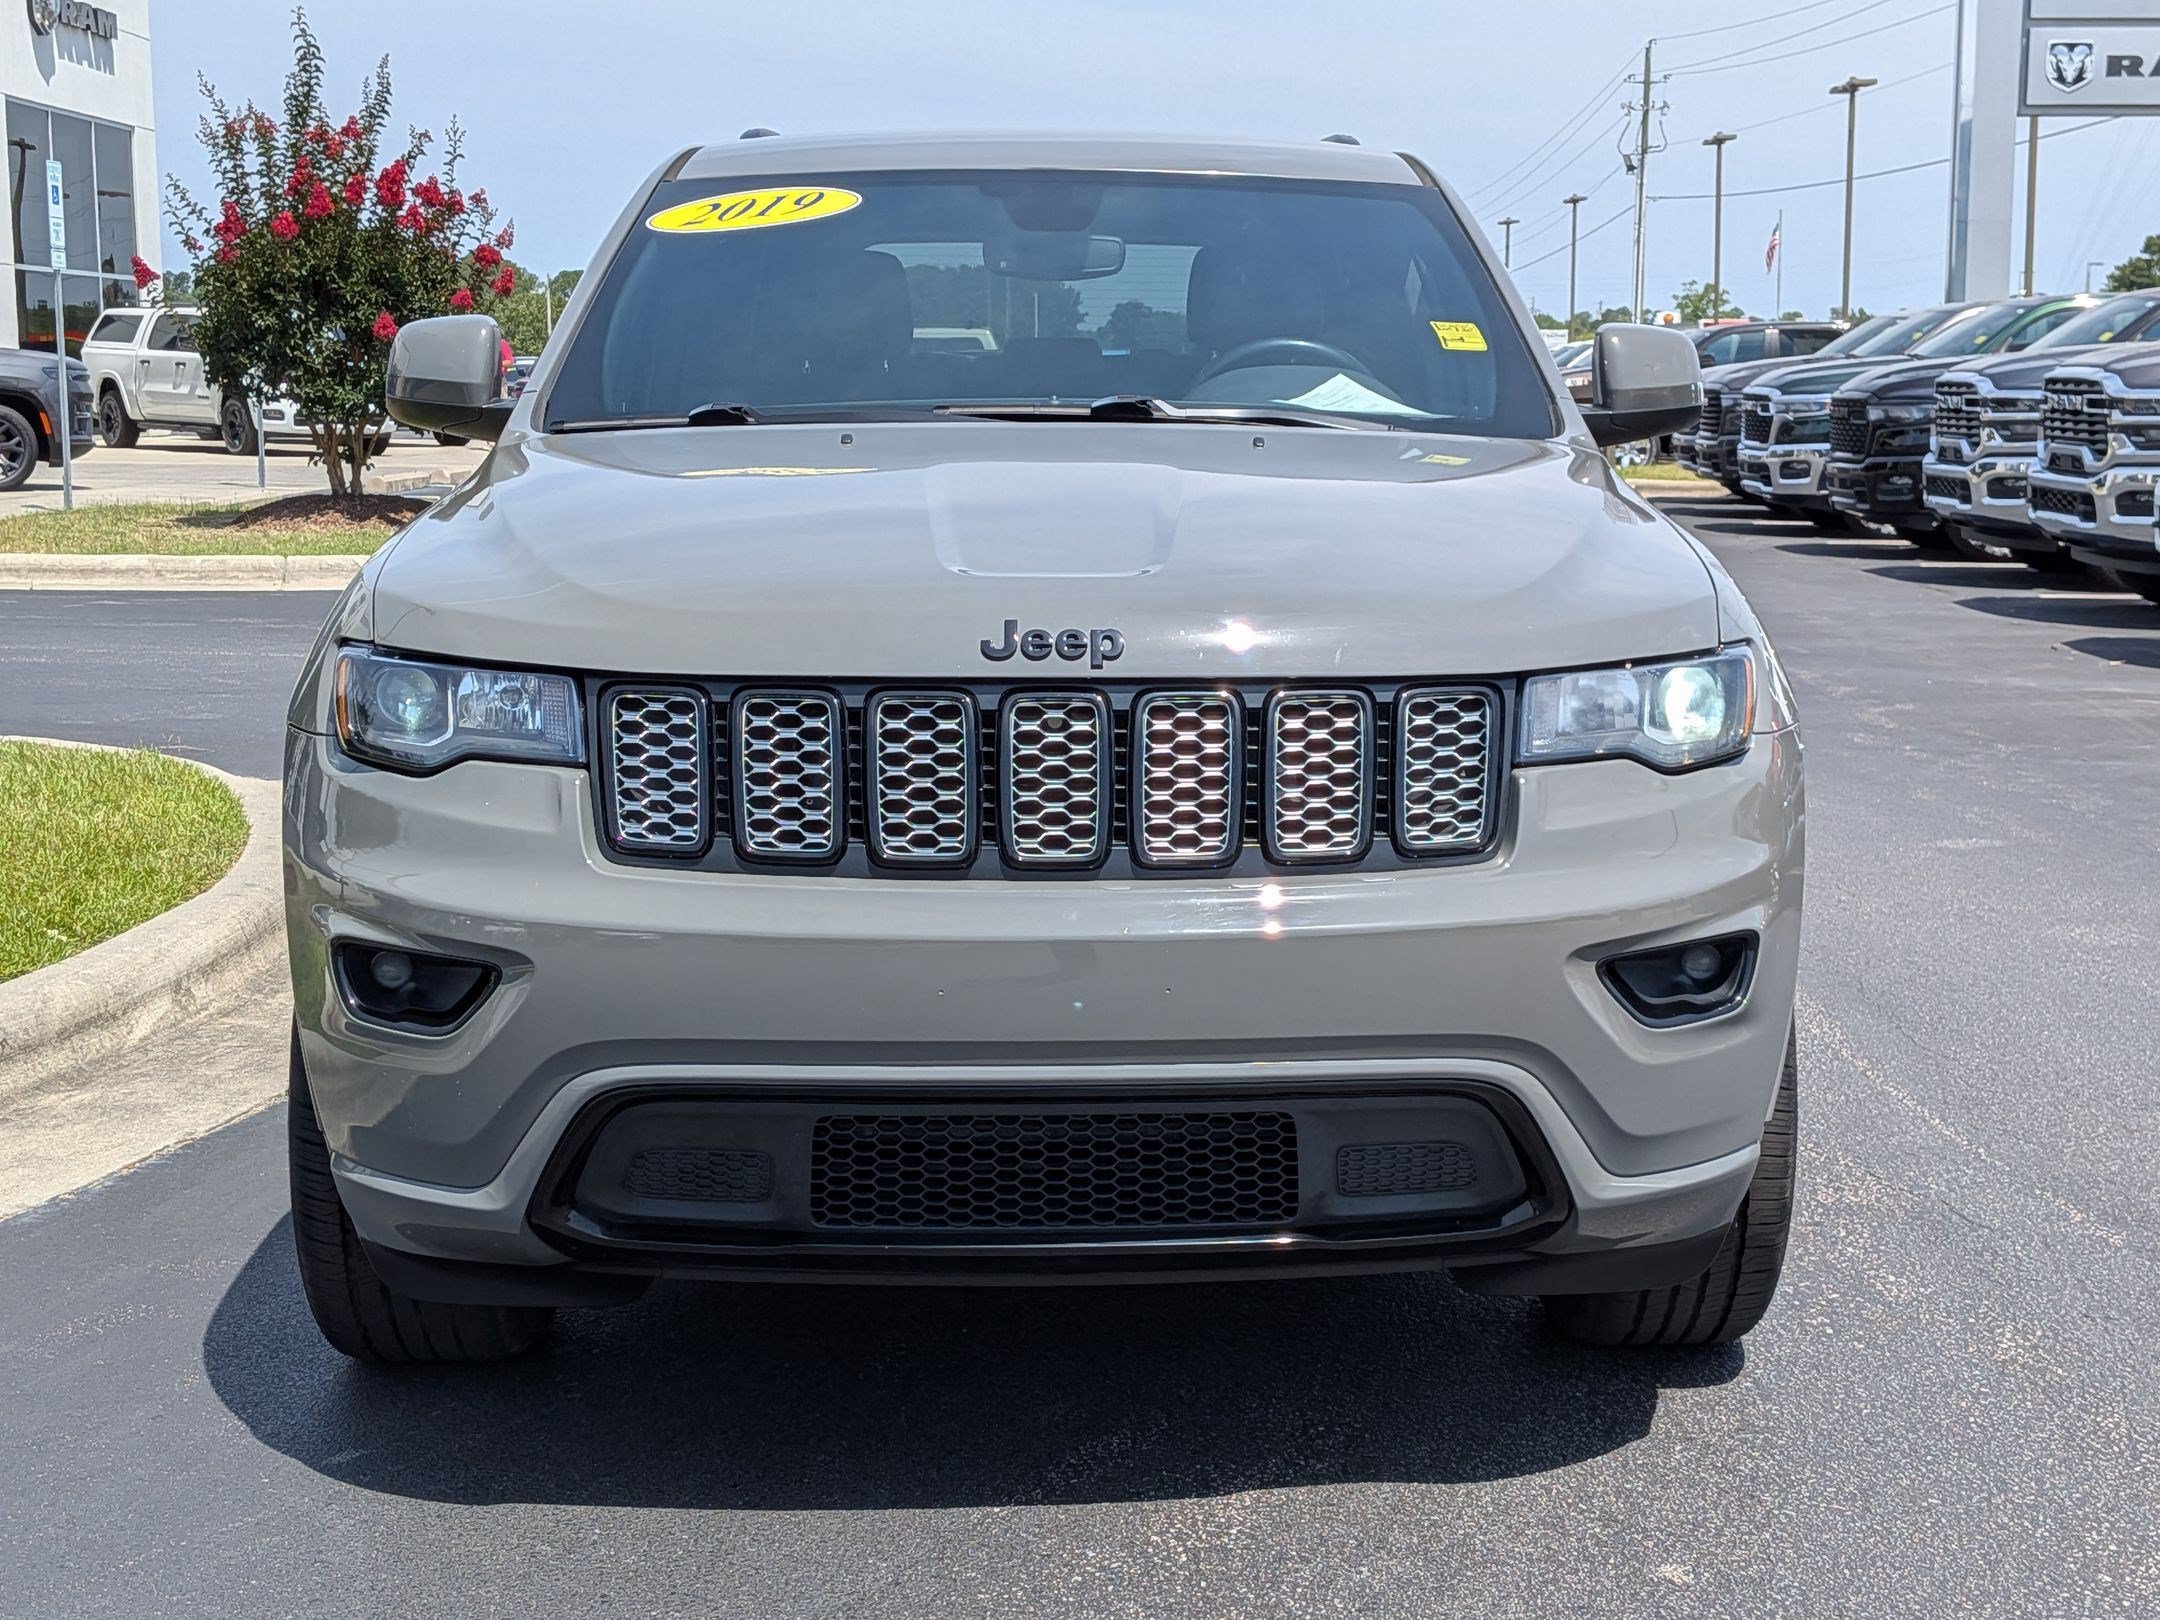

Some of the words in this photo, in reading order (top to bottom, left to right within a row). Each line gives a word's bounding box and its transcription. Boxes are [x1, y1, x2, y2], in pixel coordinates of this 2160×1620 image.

[60, 0, 118, 40] RAM
[2105, 55, 2160, 77] R
[678, 191, 825, 227] 2019
[980, 619, 1125, 670] Jeep
